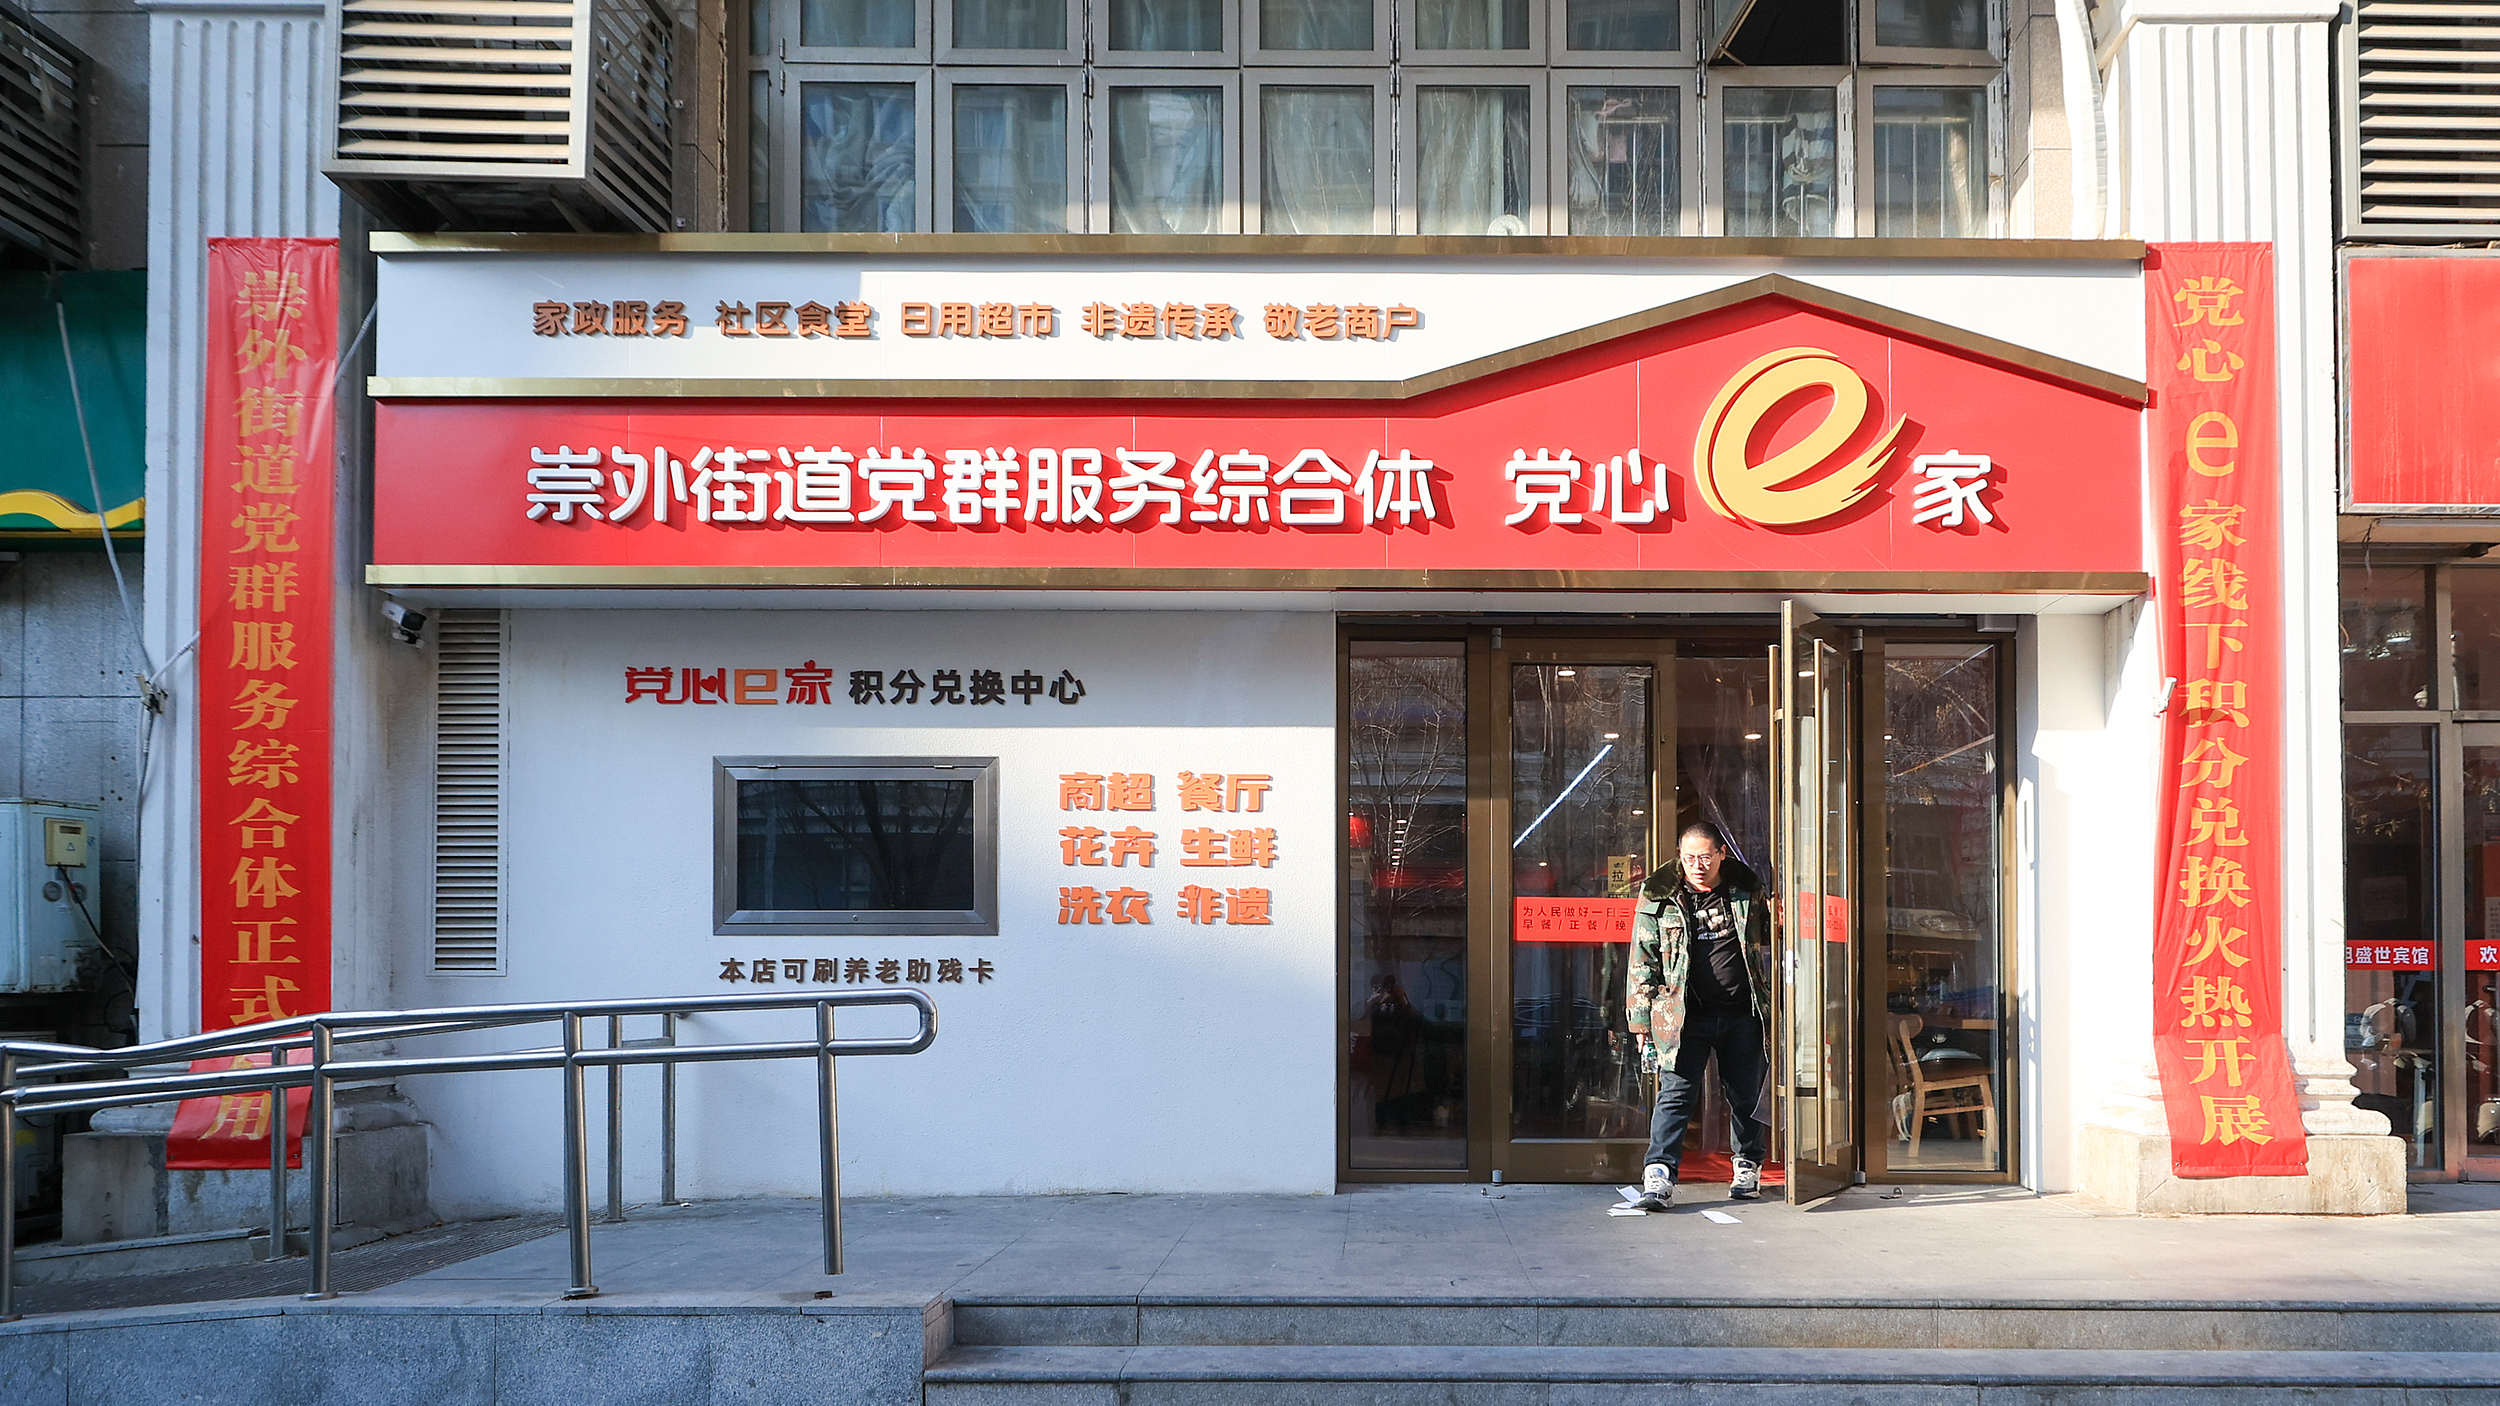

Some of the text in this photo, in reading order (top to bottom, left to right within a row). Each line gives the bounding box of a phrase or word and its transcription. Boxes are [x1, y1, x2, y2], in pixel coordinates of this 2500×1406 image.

[532, 299, 1417, 338] 家政服务 社区食堂 日用超市 非遗传承 敬老商户
[525, 444, 1438, 527] 崇外街道党群服务综合体
[198, 270, 308, 1141] 崇外街道党群服务综合体正式用
[848, 668, 1086, 706] 积分兑换中心
[2173, 276, 2274, 1147] 党心e家线下积分兑换火热开展
[1059, 770, 1270, 812] 商超 餐厅
[1059, 825, 1276, 868] 花卉 生鲜
[1612, 870, 1625, 882] 拉
[1058, 884, 1272, 925] 洗衣 非遗
[1523, 906, 1637, 918] 为人民做好一日三
[719, 957, 995, 984] 本店可刷养老助残卡
[2480, 946, 2498, 964] 欢
